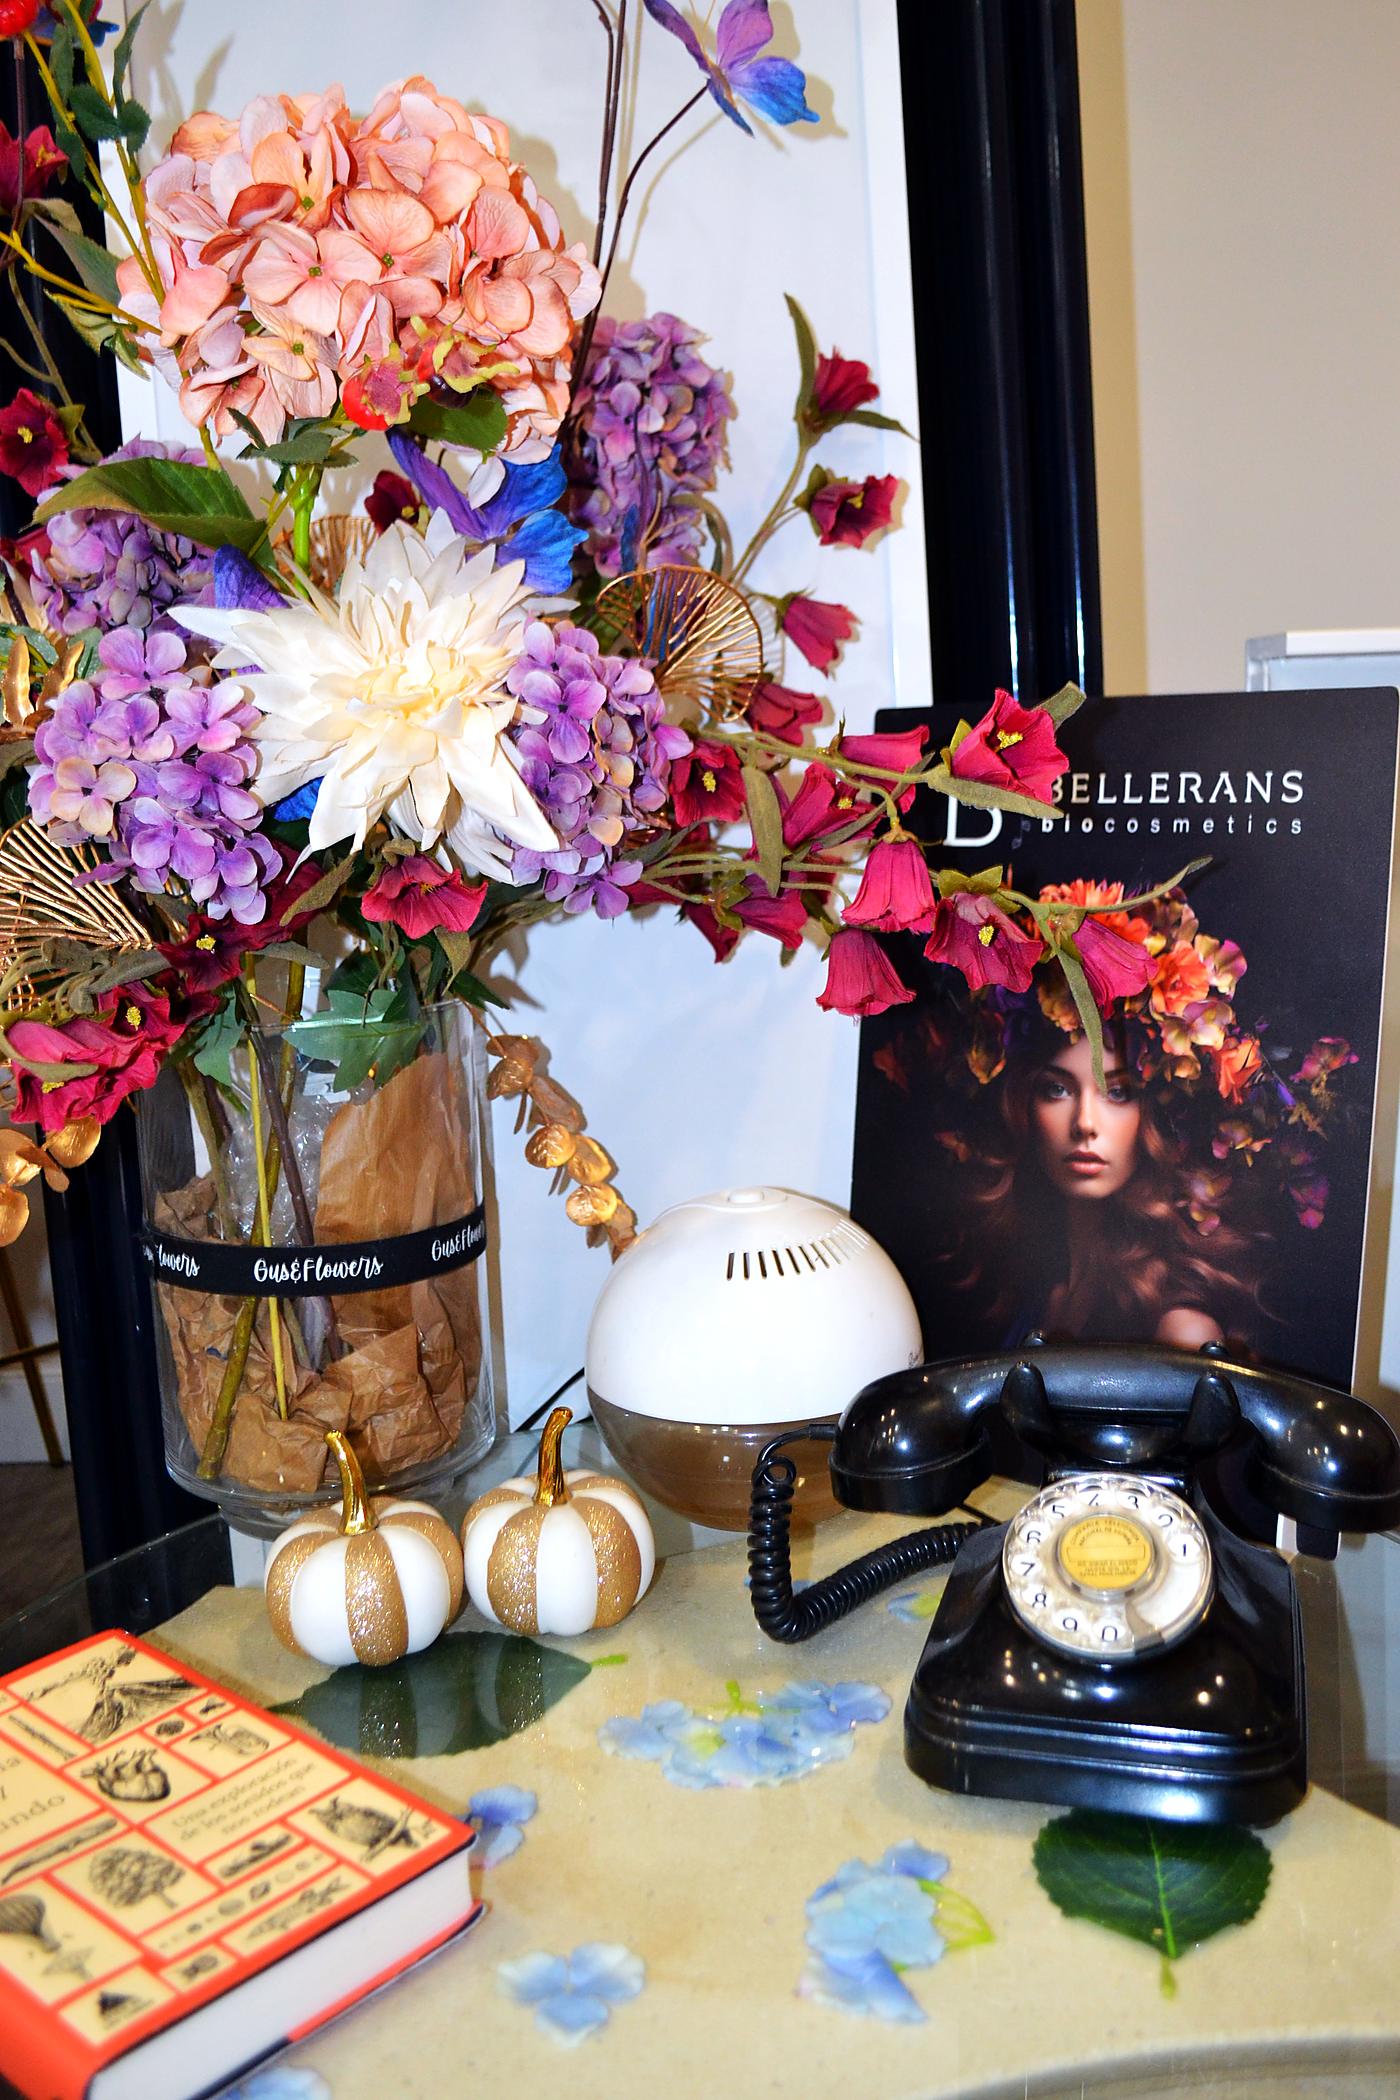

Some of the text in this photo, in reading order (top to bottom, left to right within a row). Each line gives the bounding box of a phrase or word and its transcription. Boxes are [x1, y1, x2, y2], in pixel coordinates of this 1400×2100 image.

[1051, 770, 1304, 805] BELLERANS
[1041, 814, 1302, 834] biocosmetics
[254, 1255, 384, 1284] Gus&Flowers
[1128, 1495, 1139, 1510] 3
[1052, 1504, 1065, 1519] 5
[1158, 1513, 1173, 1528] 2
[1026, 1530, 1041, 1545] 6
[1182, 1543, 1188, 1557] 1
[1020, 1561, 1036, 1576] 7
[1032, 1592, 1047, 1609] 8
[1062, 1616, 1078, 1632] 9
[1101, 1625, 1118, 1642] 0
